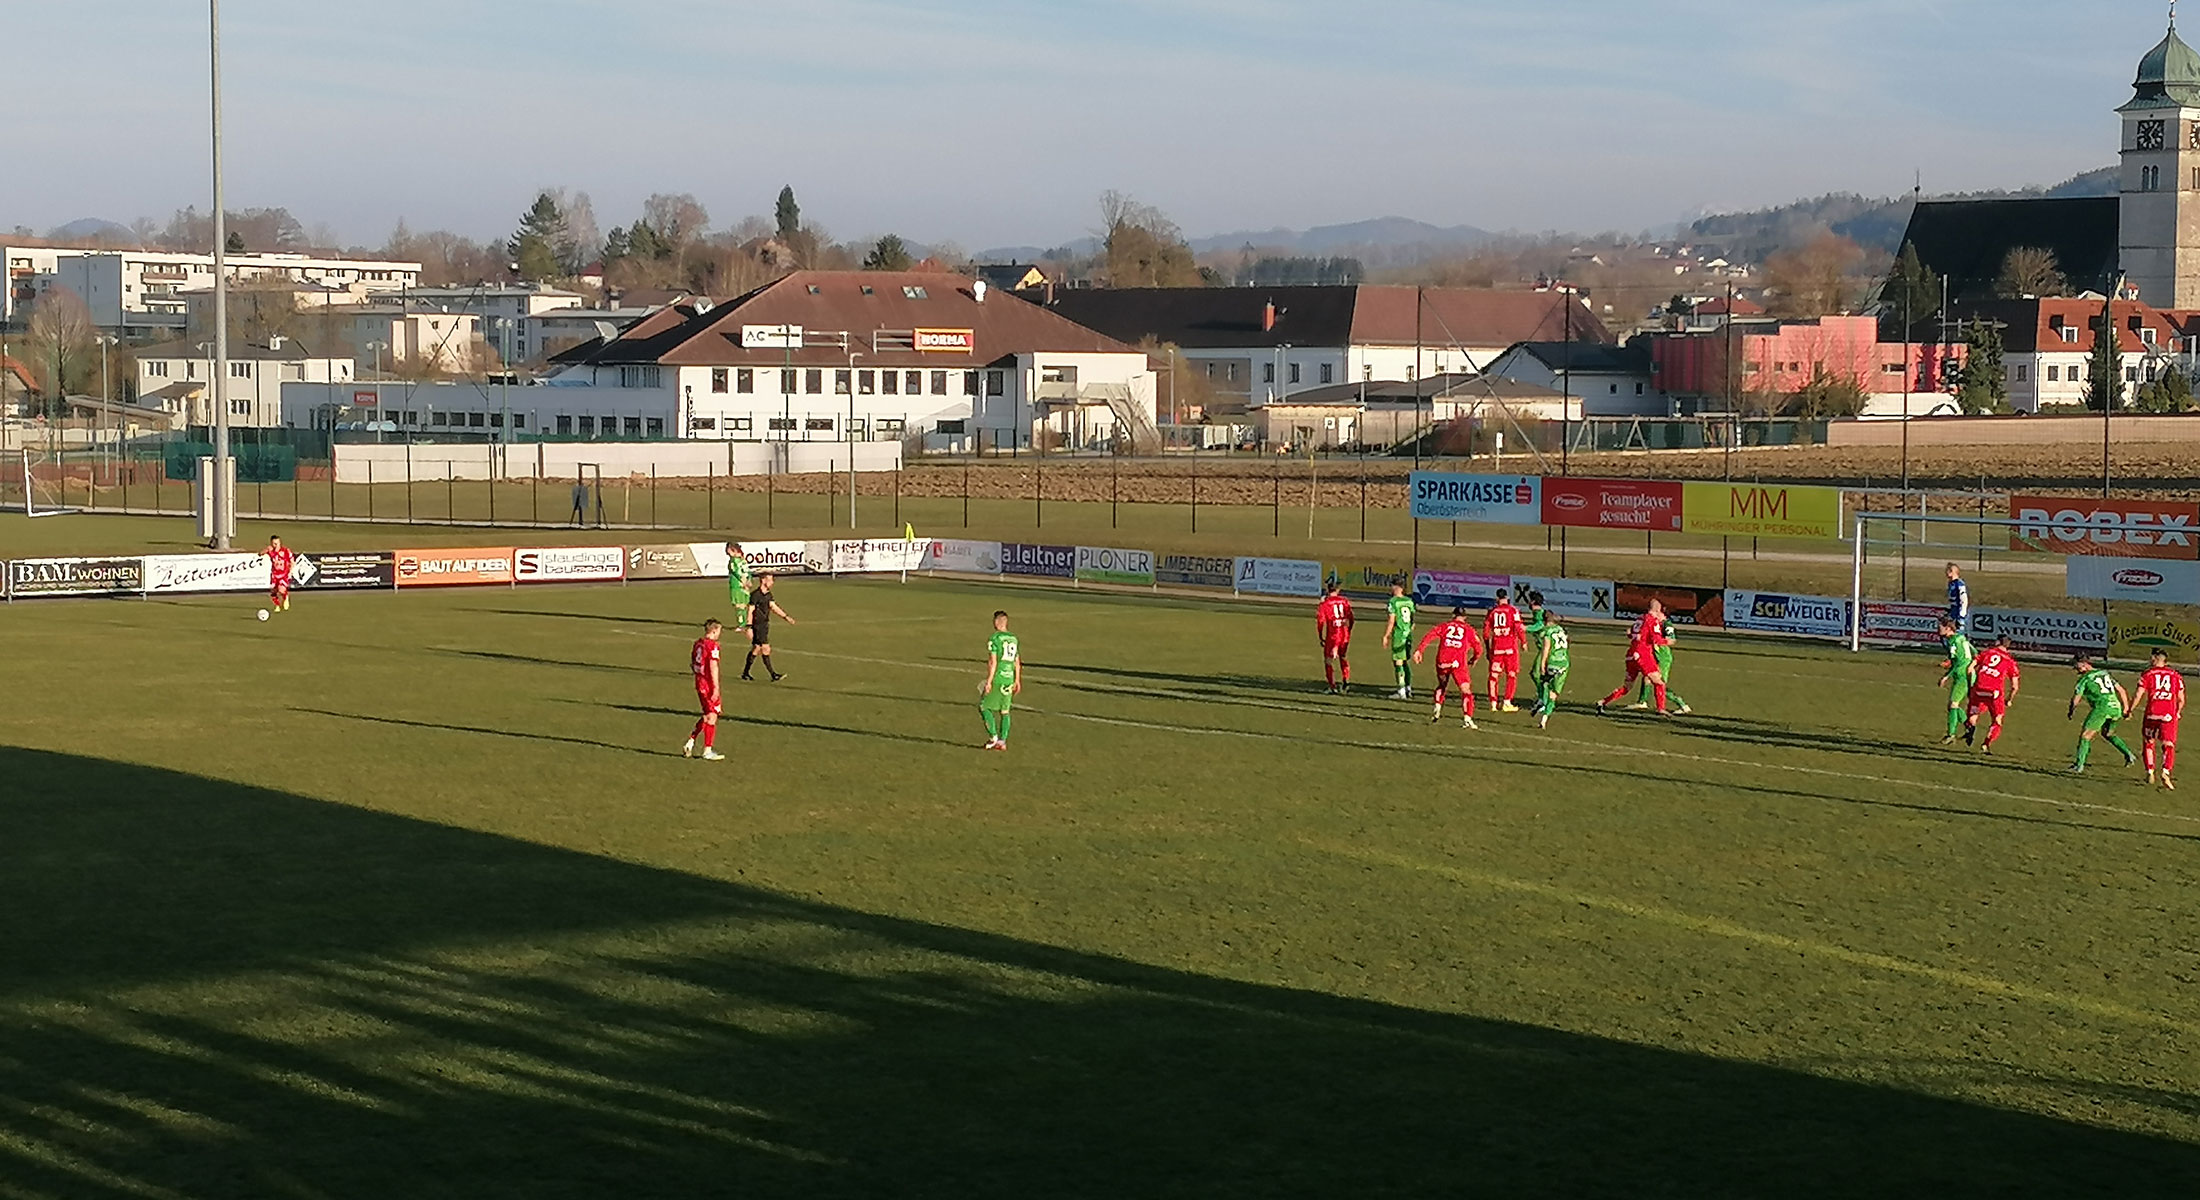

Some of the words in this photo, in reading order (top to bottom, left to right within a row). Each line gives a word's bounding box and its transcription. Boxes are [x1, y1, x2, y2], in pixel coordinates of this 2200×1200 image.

[922, 335, 966, 346] NORMA
[1417, 480, 1512, 503] SPARKASSE
[1600, 491, 1672, 510] Teamplayer
[1731, 487, 1787, 520] MM
[1417, 502, 1487, 519] Oberösterreich
[1600, 509, 1650, 524] gesucht!
[1764, 523, 1828, 537] PERSONAL
[2019, 509, 2190, 546] ROBEX
[1079, 548, 1149, 572] PLONER
[1156, 555, 1232, 574] LIMBERGER
[77, 566, 140, 581] WOHNEN
[1493, 612, 1507, 628] 10
[1755, 601, 1841, 622] SCHWEIGER
[1446, 625, 1465, 640] 23
[1988, 654, 2001, 668] 9
[2154, 674, 2171, 691] 14
